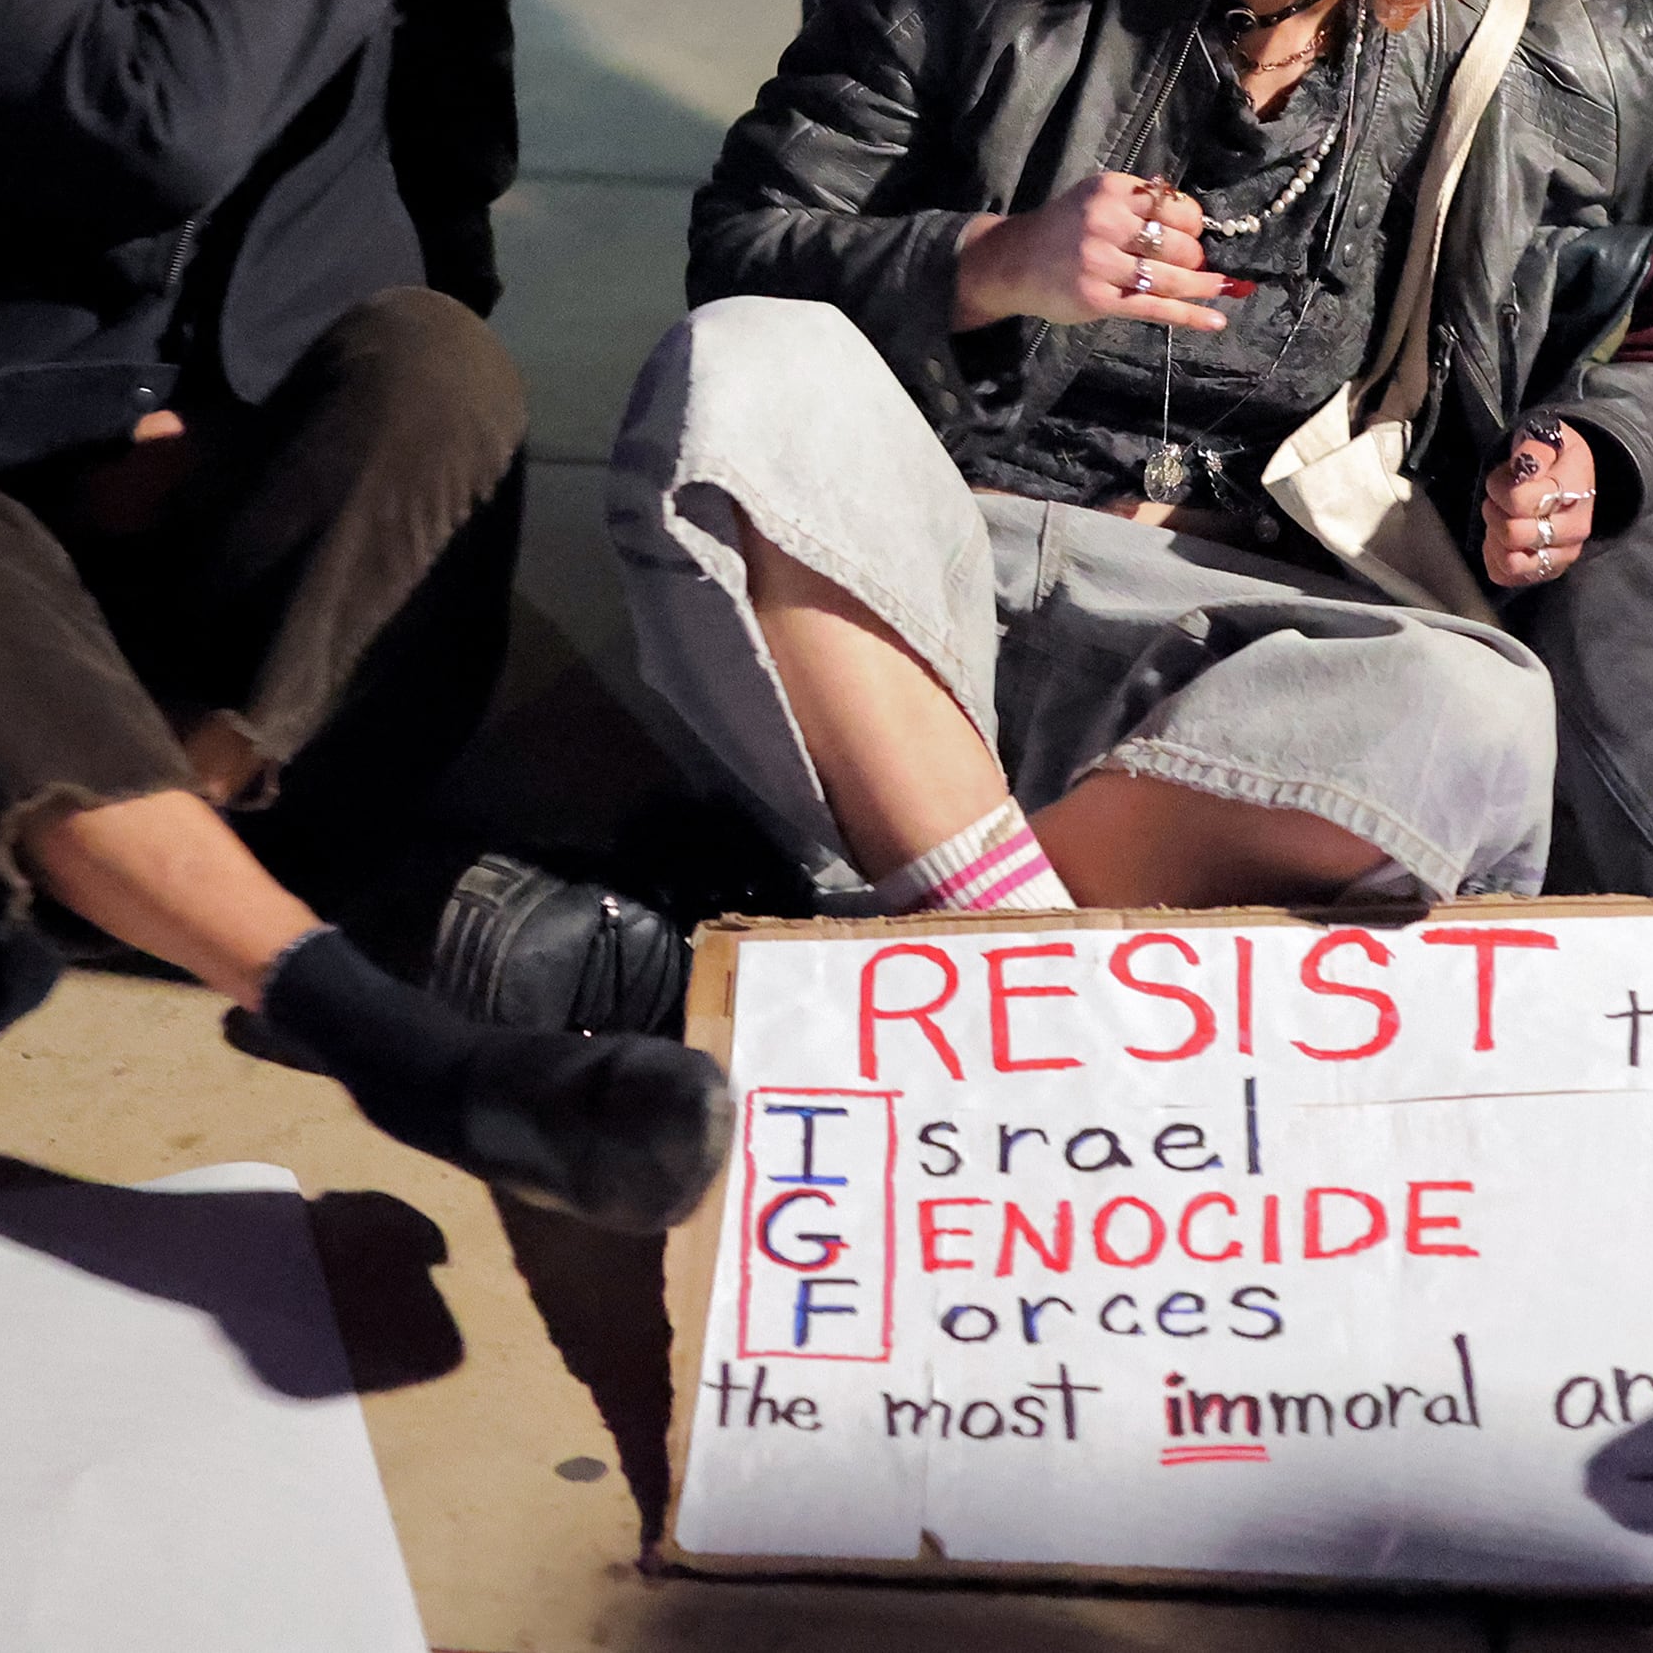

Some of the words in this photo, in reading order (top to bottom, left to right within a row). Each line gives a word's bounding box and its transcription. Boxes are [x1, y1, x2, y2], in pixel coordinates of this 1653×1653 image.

[857, 927, 1558, 1081] RESIST
[706, 1361, 823, 1434] the
[881, 1364, 1100, 1442] most
[1162, 1334, 1482, 1436] immoral
